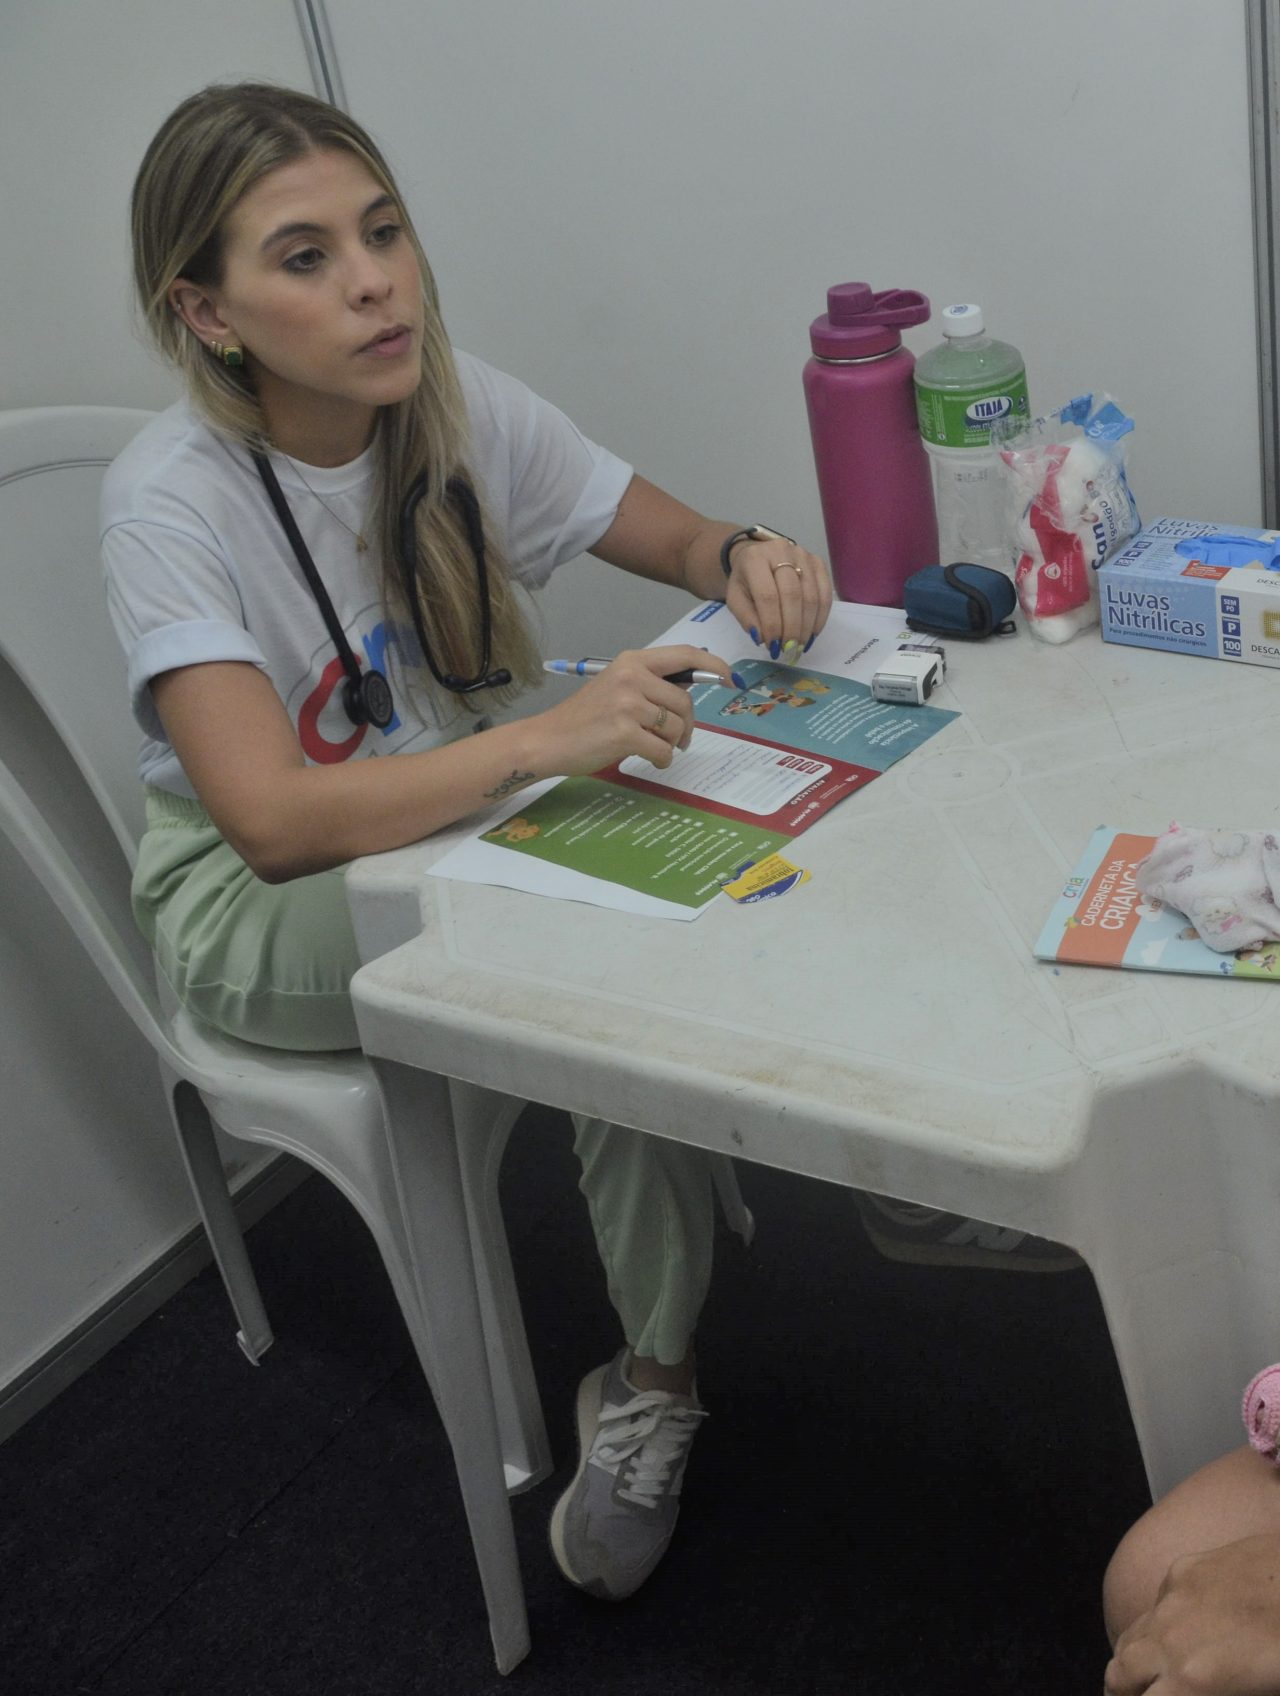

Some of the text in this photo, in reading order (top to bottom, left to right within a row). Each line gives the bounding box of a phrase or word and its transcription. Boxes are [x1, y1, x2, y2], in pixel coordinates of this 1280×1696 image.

[1100, 500, 1118, 543] lgodão
[1158, 518, 1218, 531] Luvas
[1107, 585, 1170, 611] Luvas
[1223, 598, 1237, 607] SEM
[1108, 605, 1206, 637] Nitrílicas
[1227, 622, 1237, 633] P
[1223, 640, 1240, 652] 100
[1081, 859, 1126, 926] CADERNETA DA
